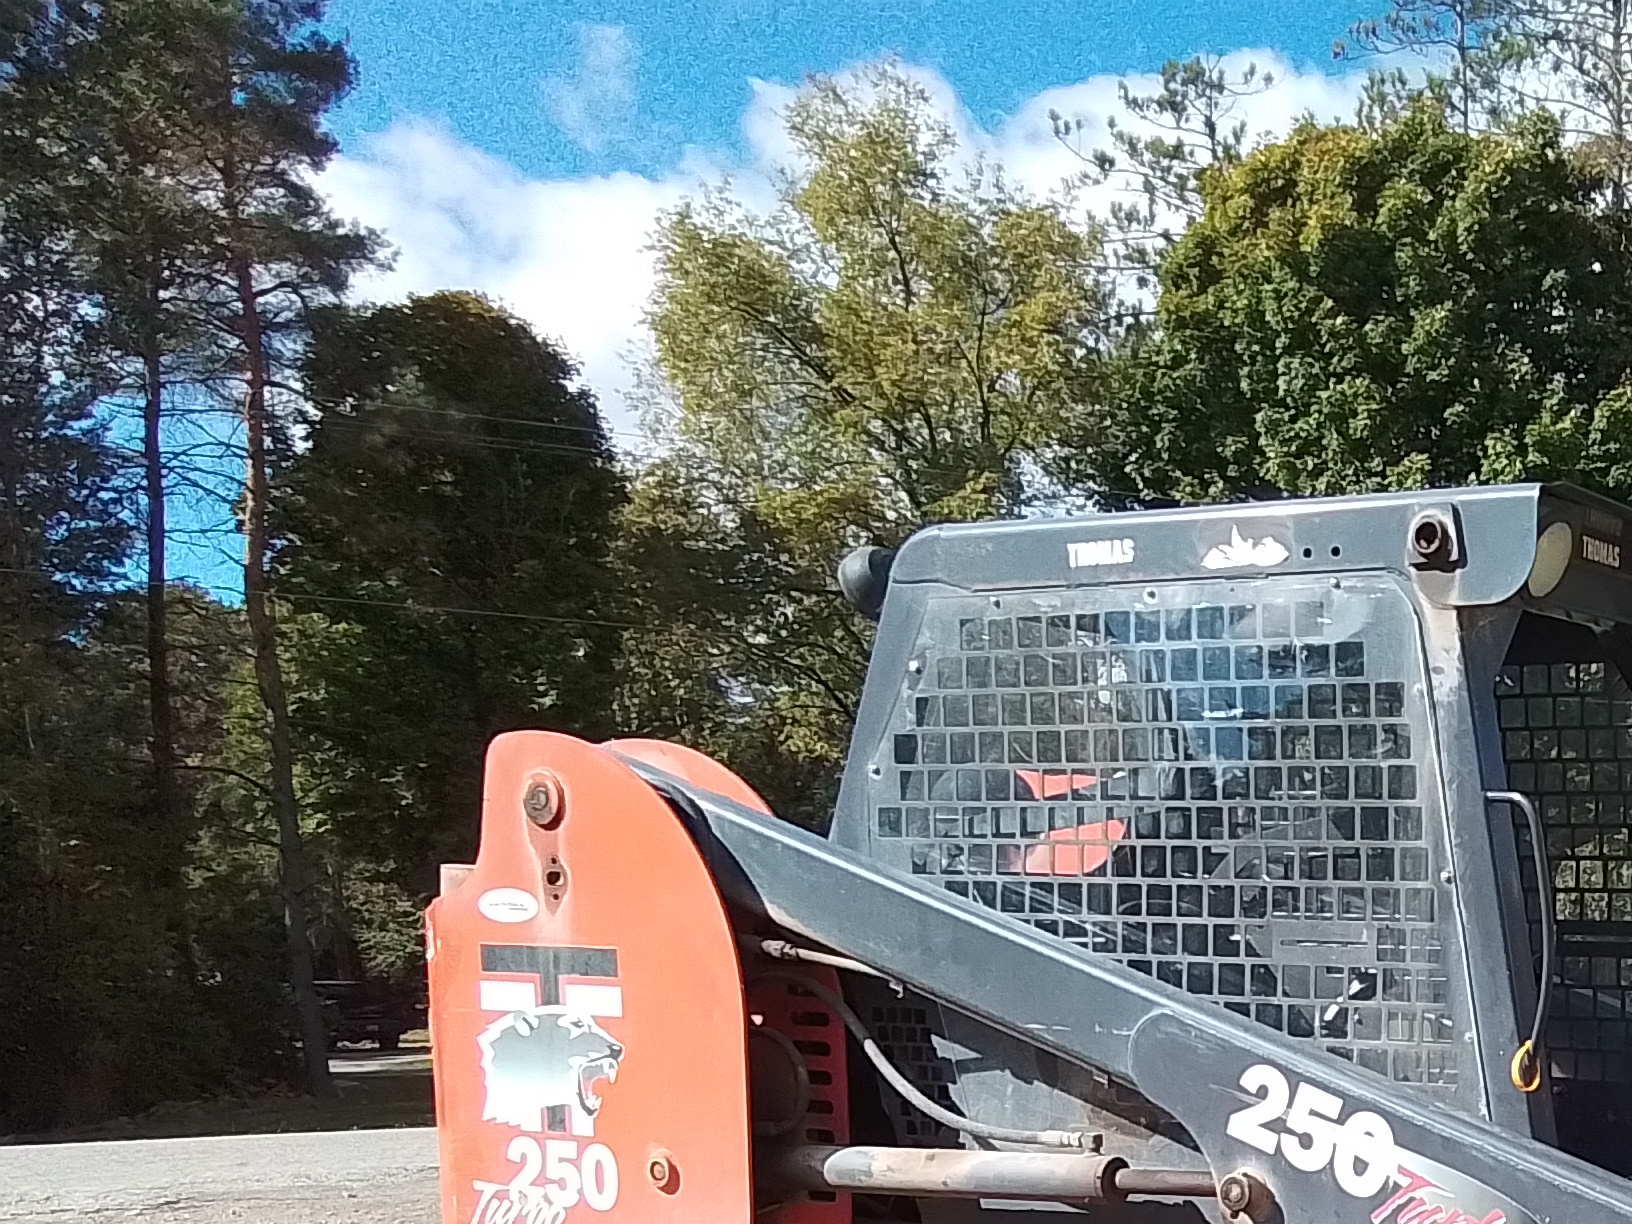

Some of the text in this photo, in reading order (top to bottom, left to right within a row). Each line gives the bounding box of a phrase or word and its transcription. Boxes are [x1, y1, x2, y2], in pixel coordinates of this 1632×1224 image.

[1066, 538, 1135, 568] THOMAS
[1582, 534, 1620, 568] THOMAS
[1226, 1064, 1395, 1198] 250
[507, 1136, 619, 1211] 250
